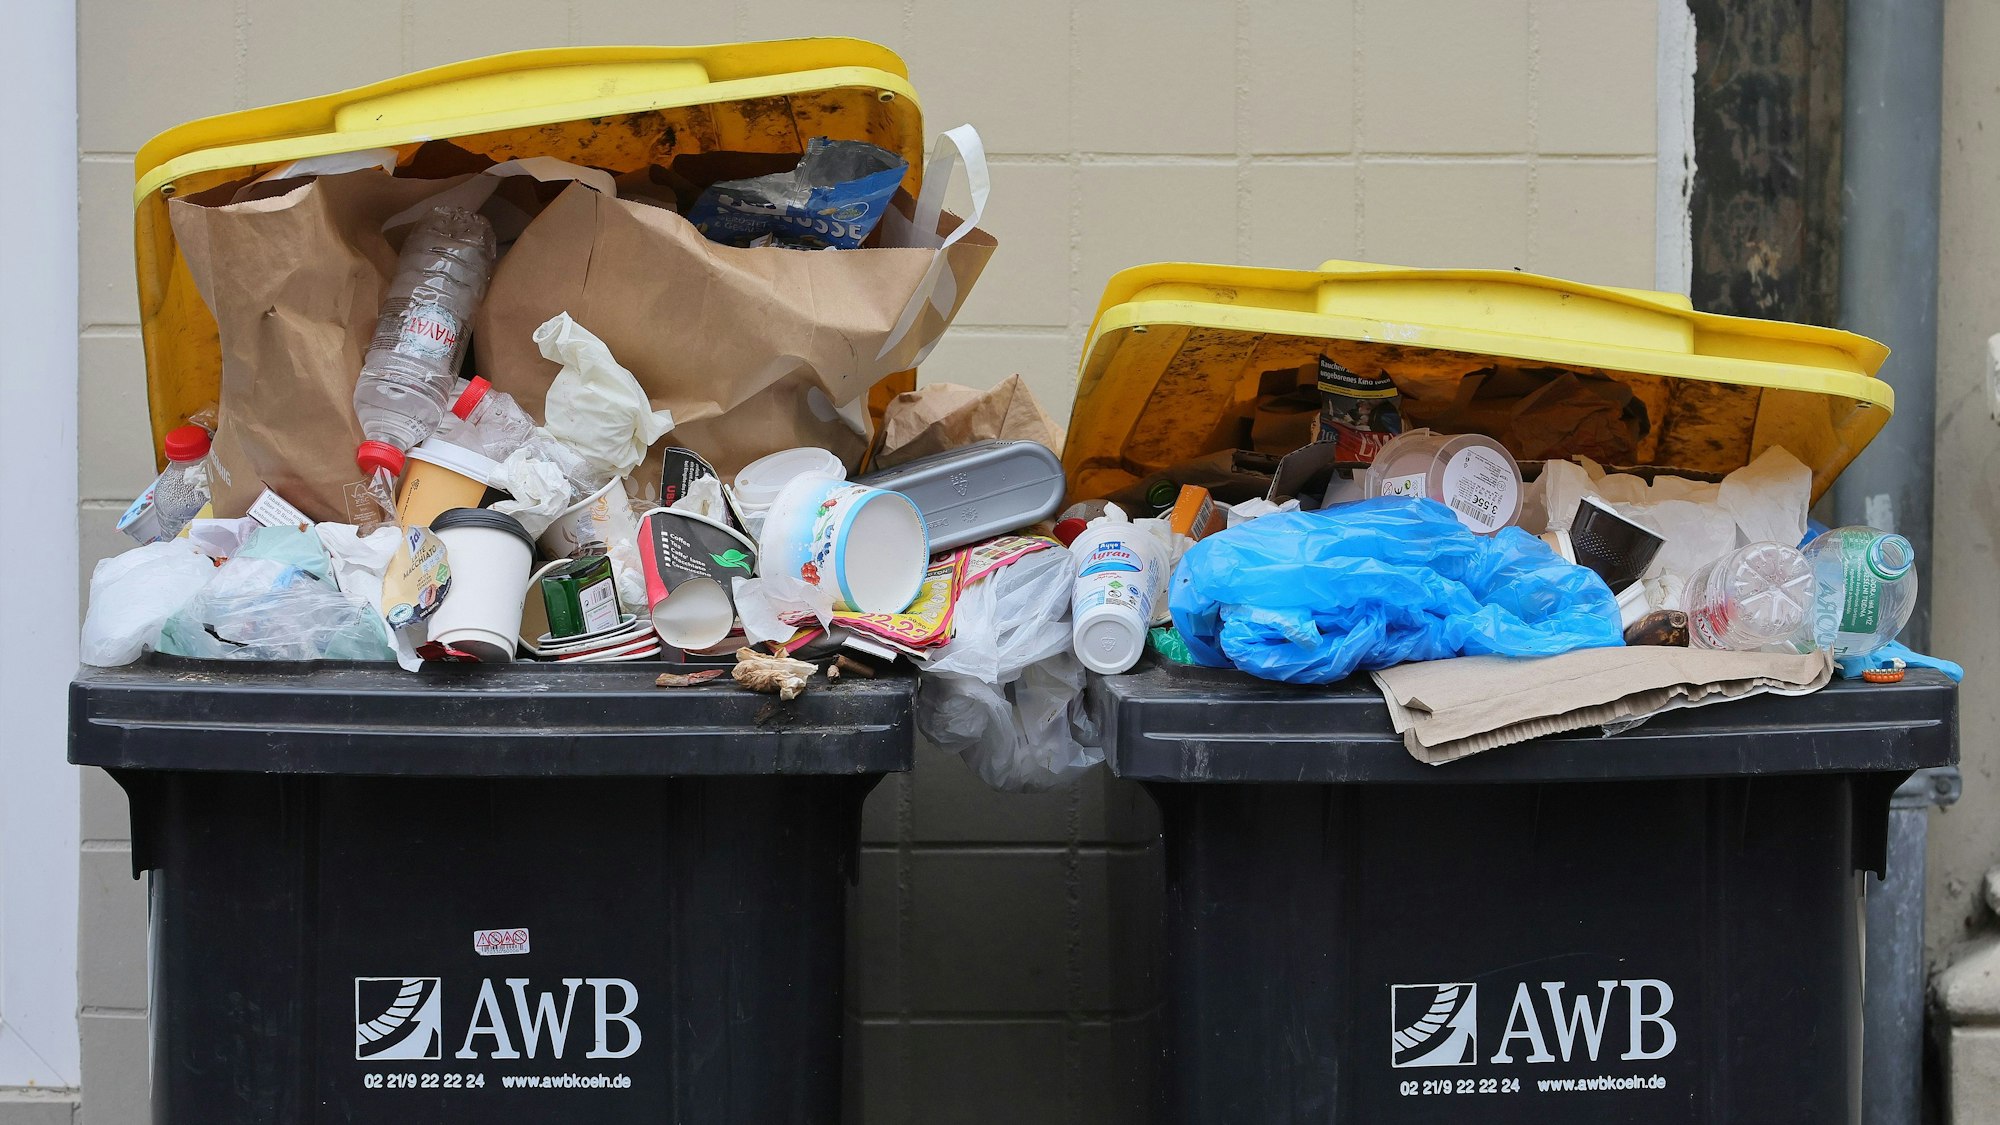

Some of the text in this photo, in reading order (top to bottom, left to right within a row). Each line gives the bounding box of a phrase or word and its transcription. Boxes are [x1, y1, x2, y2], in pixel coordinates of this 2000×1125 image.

[405, 316, 455, 348] HAYAT
[1472, 494, 1499, 515] 3,55€
[670, 533, 690, 548] Coffee
[670, 539, 682, 550] Tea
[1088, 551, 1131, 563] Ayran
[455, 977, 642, 1059] AWB
[1491, 978, 1677, 1063] AWB
[364, 1072, 632, 1089] 02 21/9 22 22 24 www.awbkoeln.de
[1400, 1074, 1667, 1096] 02 21/9 22 22 24 www.awbkoeln.de
